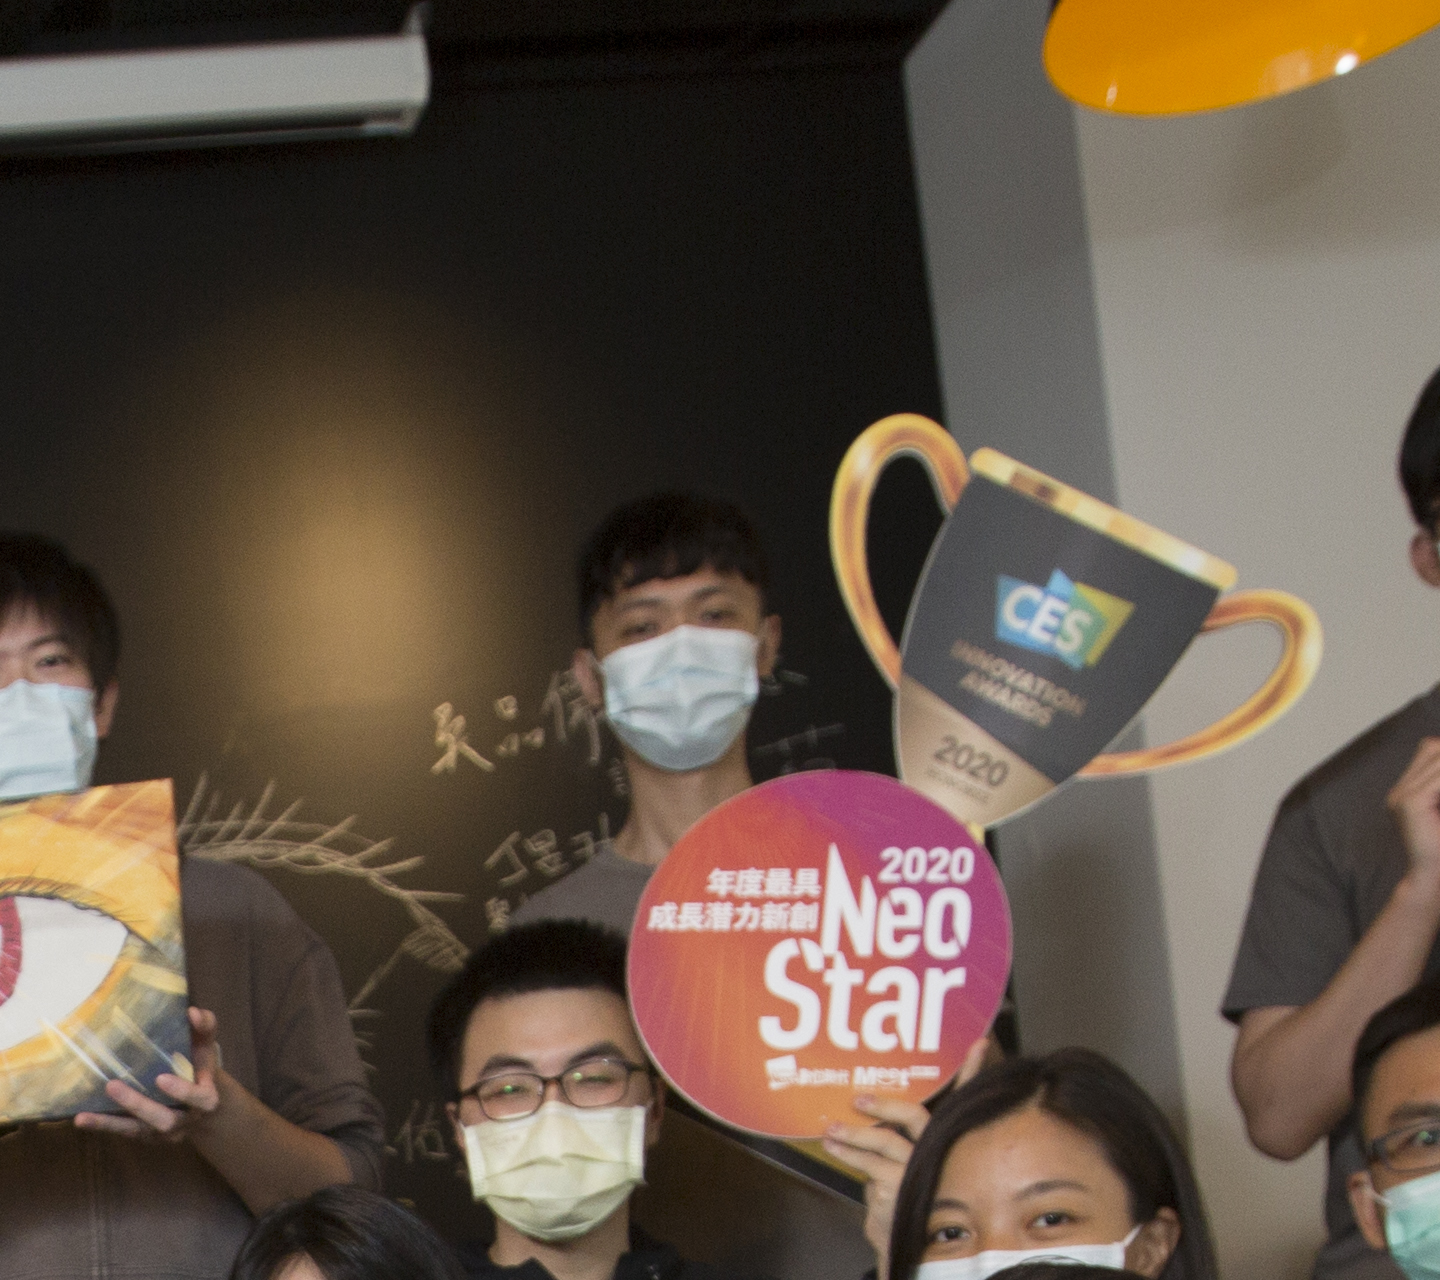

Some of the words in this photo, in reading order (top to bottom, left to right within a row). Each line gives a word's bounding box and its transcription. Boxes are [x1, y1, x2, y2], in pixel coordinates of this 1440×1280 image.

[1002, 584, 1095, 656] CES
[949, 638, 1089, 718] INNOVATION
[958, 668, 1054, 729] AWARDS
[934, 733, 1010, 787] 2020
[706, 867, 822, 898] 年度最具
[877, 846, 976, 885] 2020
[820, 841, 972, 960] Neo
[757, 937, 967, 1053] Star
